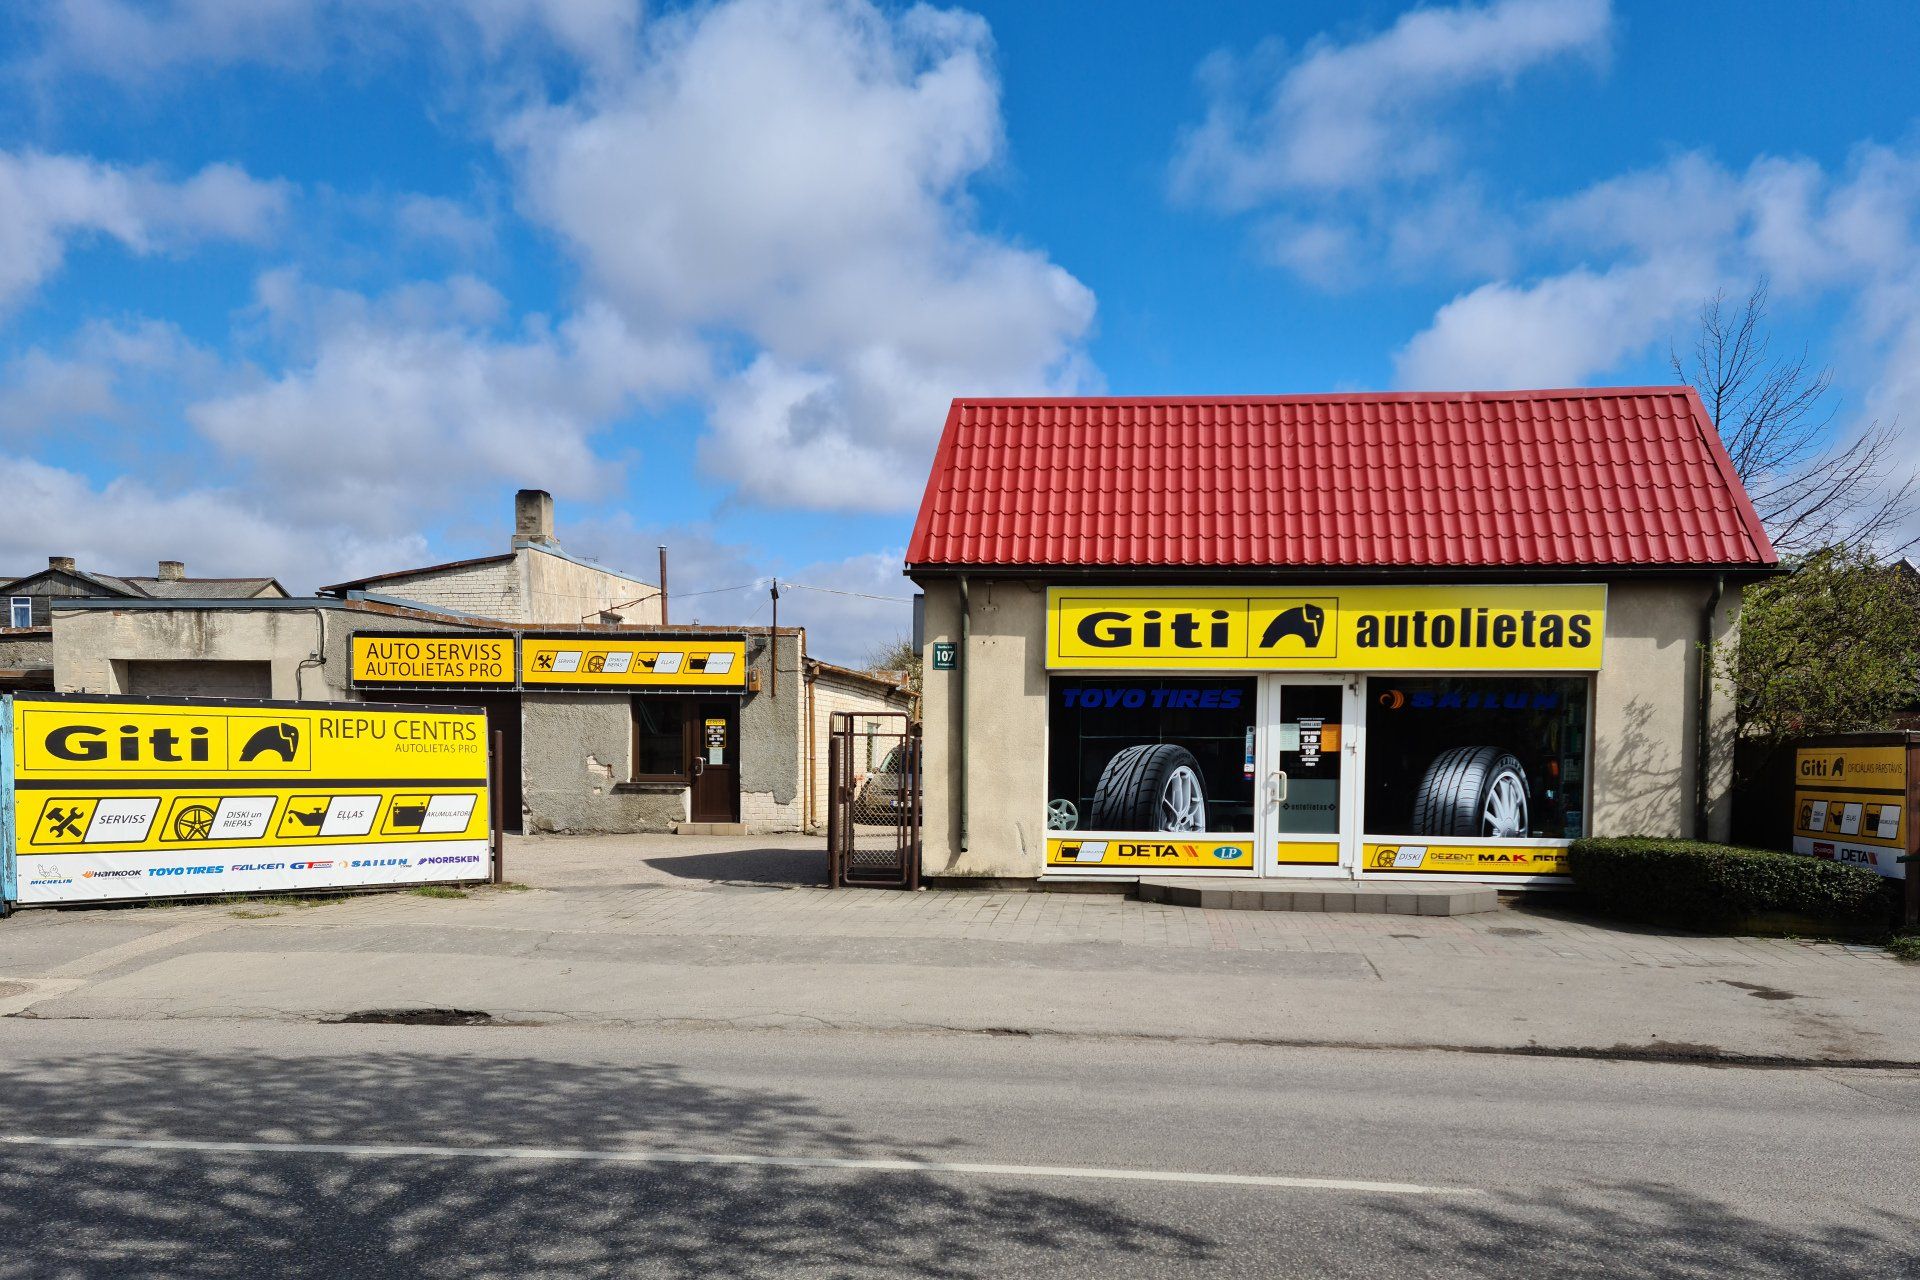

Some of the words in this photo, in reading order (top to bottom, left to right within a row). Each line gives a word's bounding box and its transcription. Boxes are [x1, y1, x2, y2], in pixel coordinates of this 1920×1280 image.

[1077, 610, 1229, 648] Giti
[1356, 608, 1591, 648] autolietas
[366, 643, 420, 659] AUTO
[426, 644, 501, 660] SERVISS
[936, 650, 954, 661] 107
[366, 662, 464, 676] AUTOLIETAS
[469, 663, 502, 677] PRO
[1062, 689, 1146, 708] TOYO
[1150, 689, 1243, 708] TIRES
[1410, 692, 1560, 709] SAILUN
[320, 718, 386, 739] RIEPU
[394, 720, 477, 741] CENTRS
[45, 725, 208, 762] Giti
[395, 743, 456, 753] AUTOLIETAS
[458, 744, 478, 753] PRO
[1801, 759, 1827, 776] Giti
[99, 814, 146, 824] SERVISS
[1118, 845, 1179, 857] DETA
[1221, 848, 1237, 859] LP
[1841, 849, 1869, 862] DETA
[290, 861, 319, 869] GT
[351, 858, 408, 867] SAILUN
[428, 856, 480, 864] NORRSKEN
[149, 867, 184, 876] TOYO
[187, 866, 224, 875] TIRES
[231, 863, 285, 871] FALKEN
